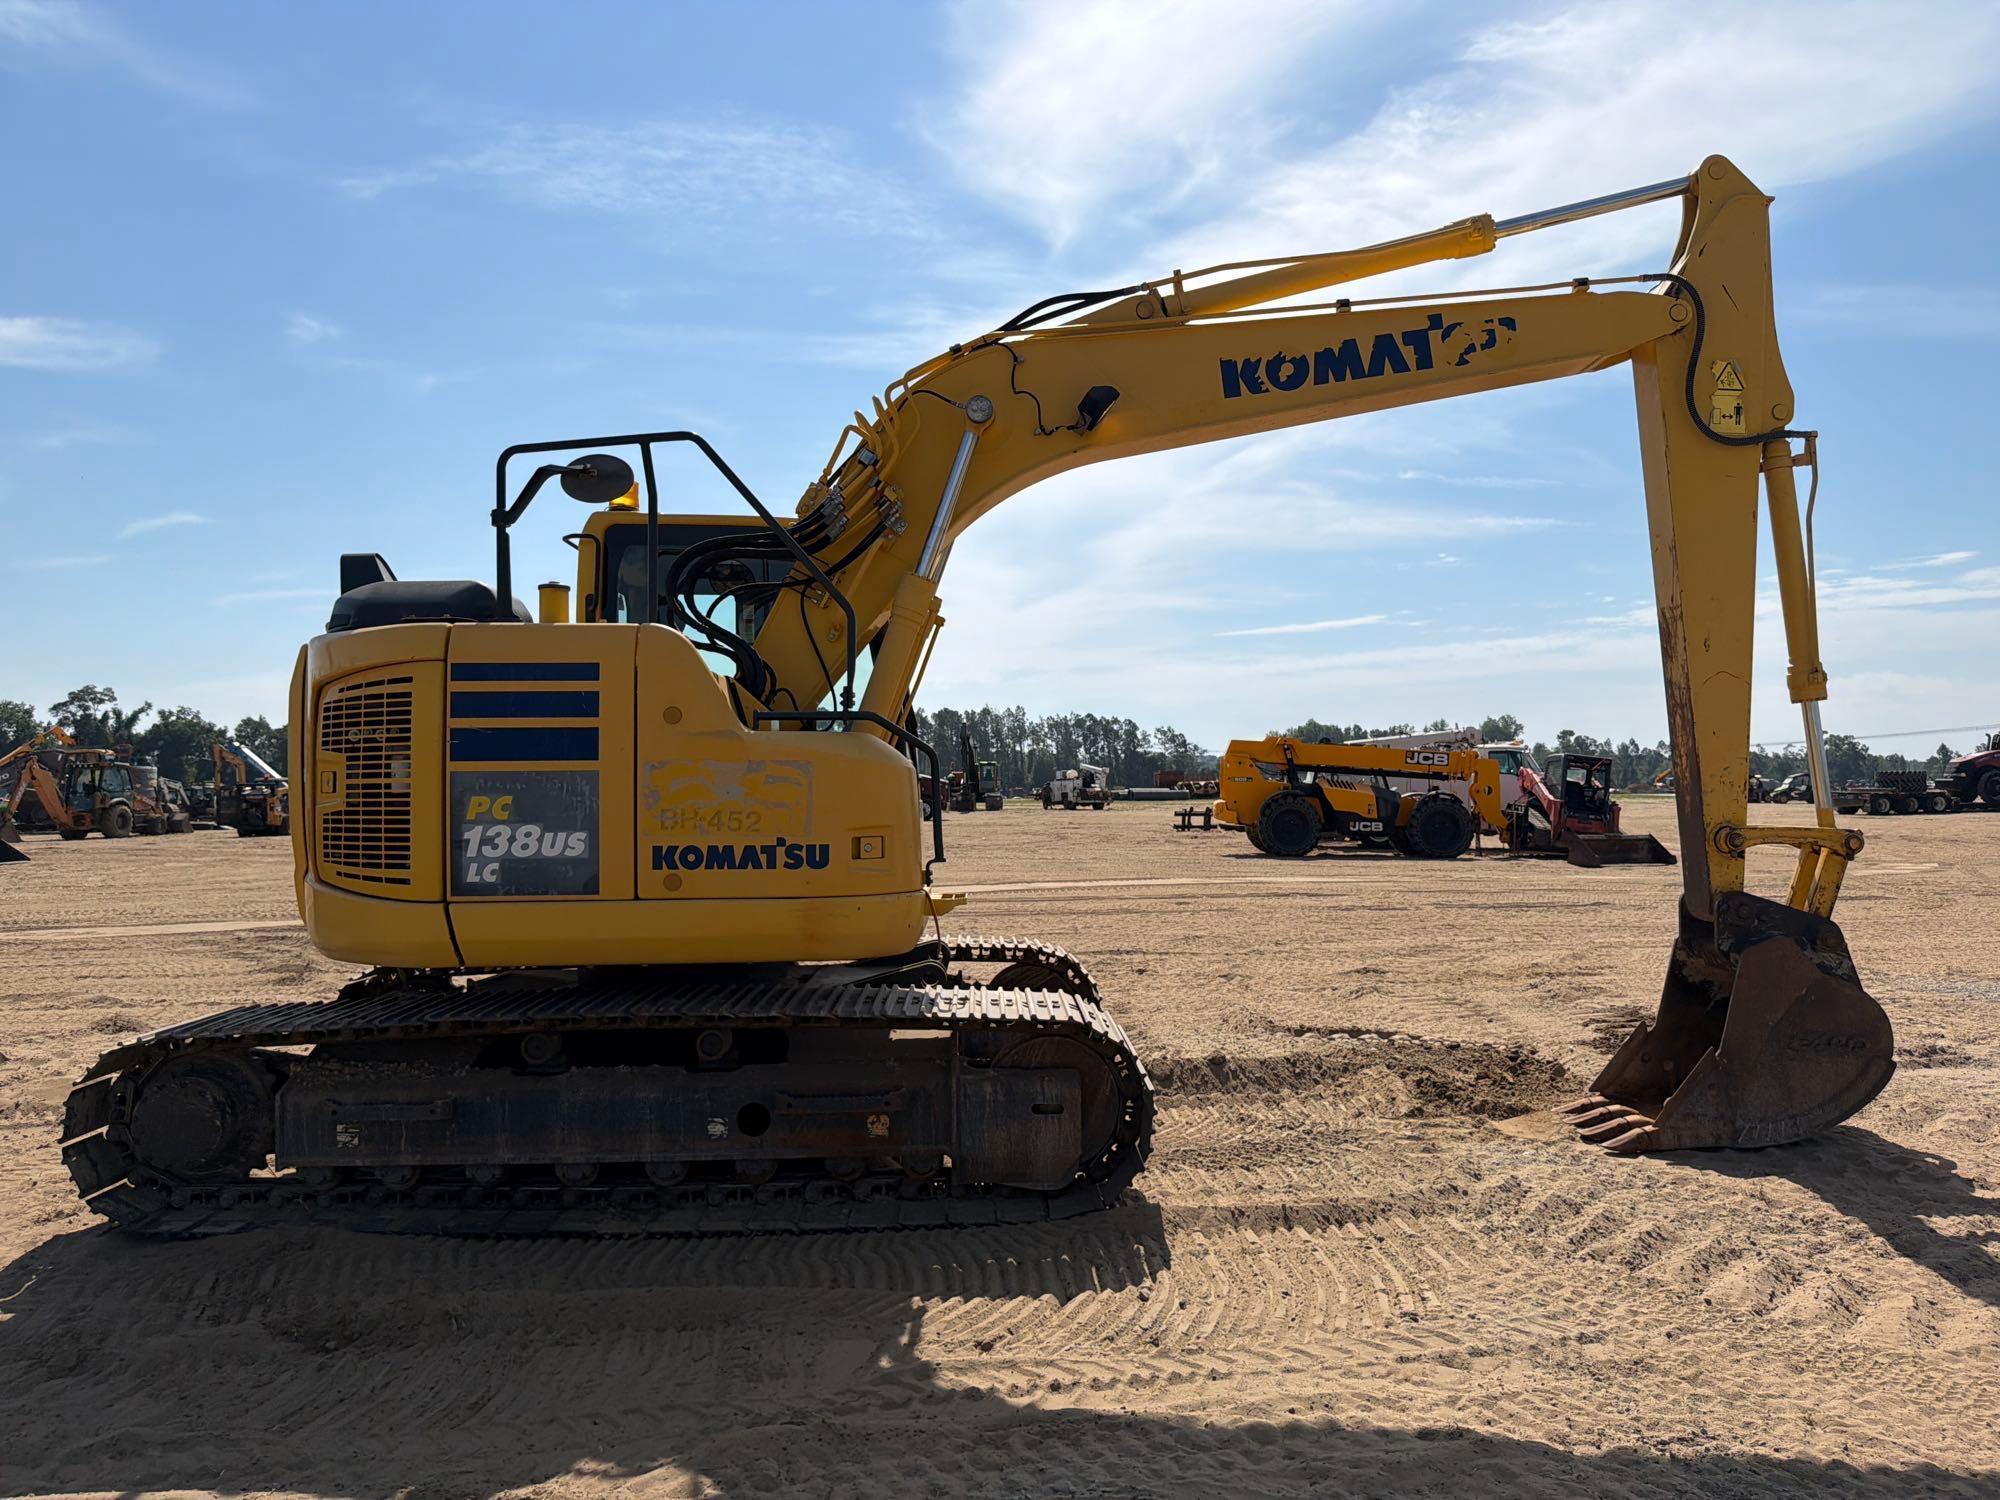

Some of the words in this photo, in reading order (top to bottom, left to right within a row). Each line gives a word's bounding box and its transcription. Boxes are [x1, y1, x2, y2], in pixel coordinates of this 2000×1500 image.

[1219, 313, 1517, 399] KOMAT
[1407, 752, 1449, 766] JCB
[466, 796, 513, 820] PC
[1349, 821, 1383, 832] JCB
[652, 837, 830, 871] KOMATSU
[466, 863, 500, 883] LC
